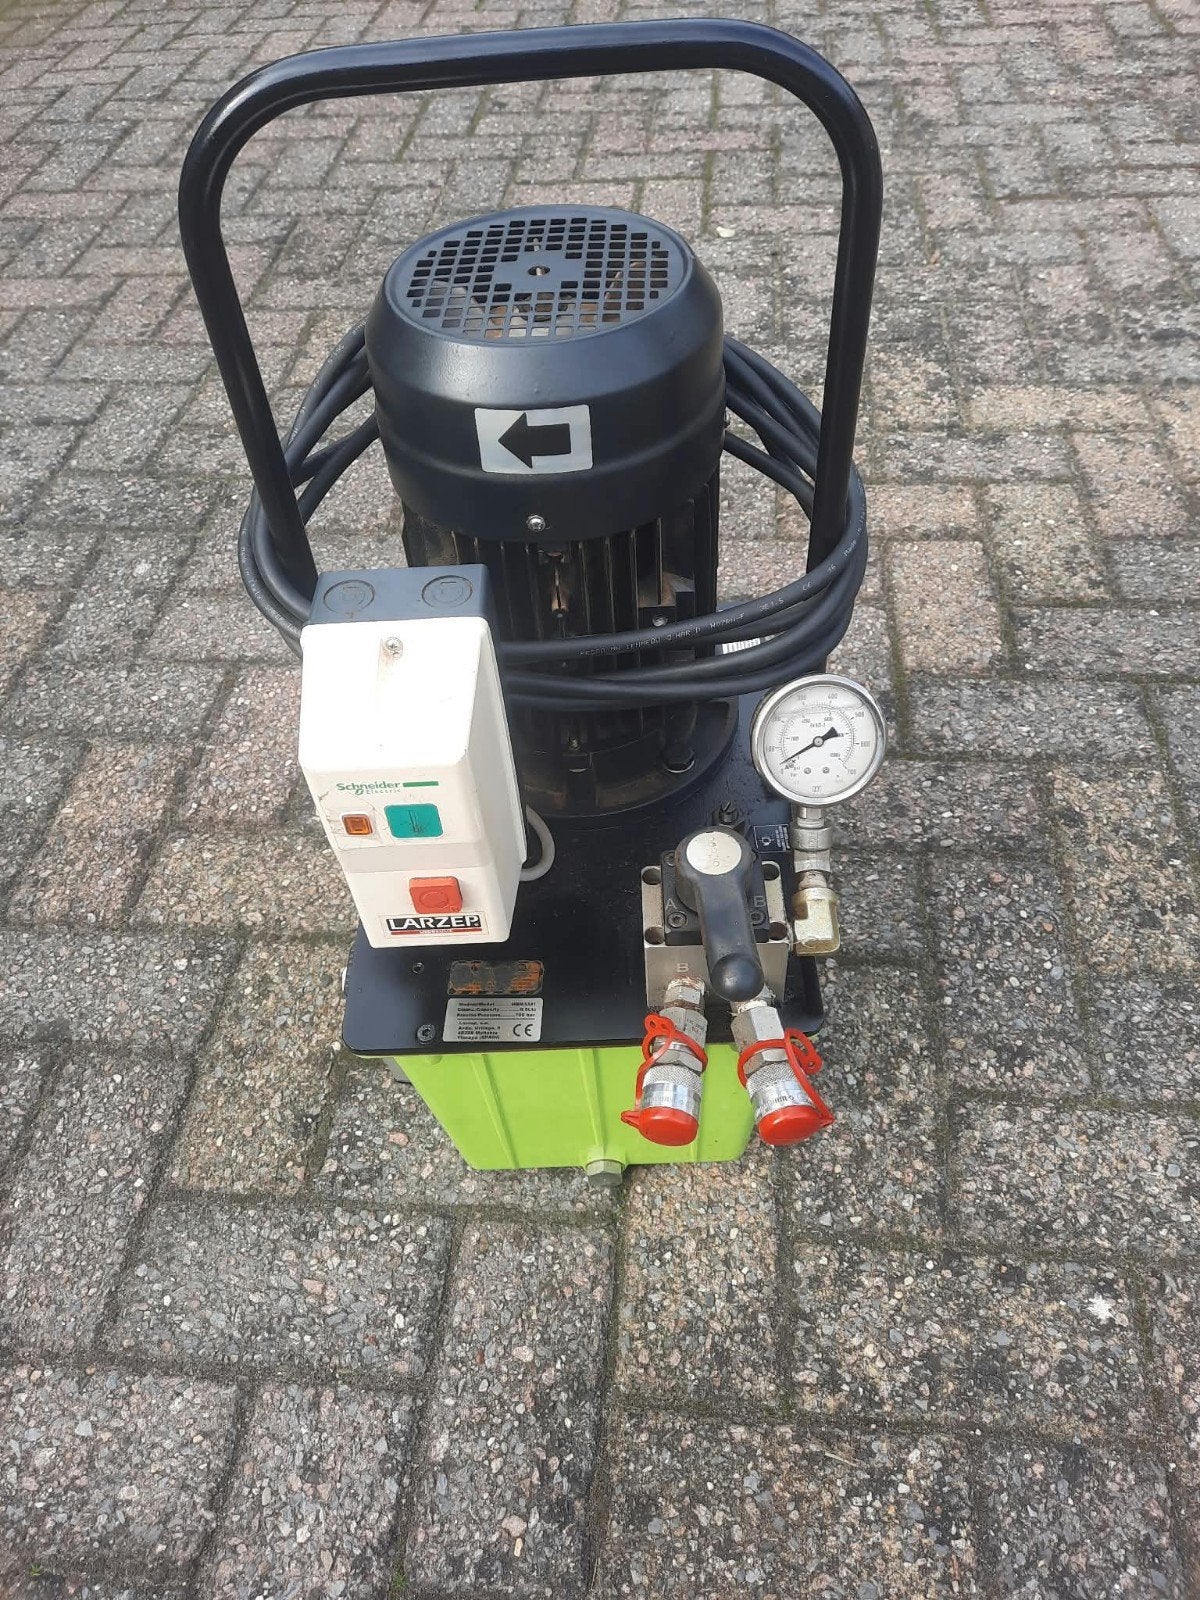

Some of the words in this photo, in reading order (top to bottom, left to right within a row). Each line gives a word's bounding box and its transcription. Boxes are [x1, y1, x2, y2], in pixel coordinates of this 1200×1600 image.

[336, 781, 401, 791] Schneider
[665, 898, 678, 910] A
[753, 895, 766, 907] B
[388, 915, 479, 930] LARZEP
[676, 962, 690, 972] B
